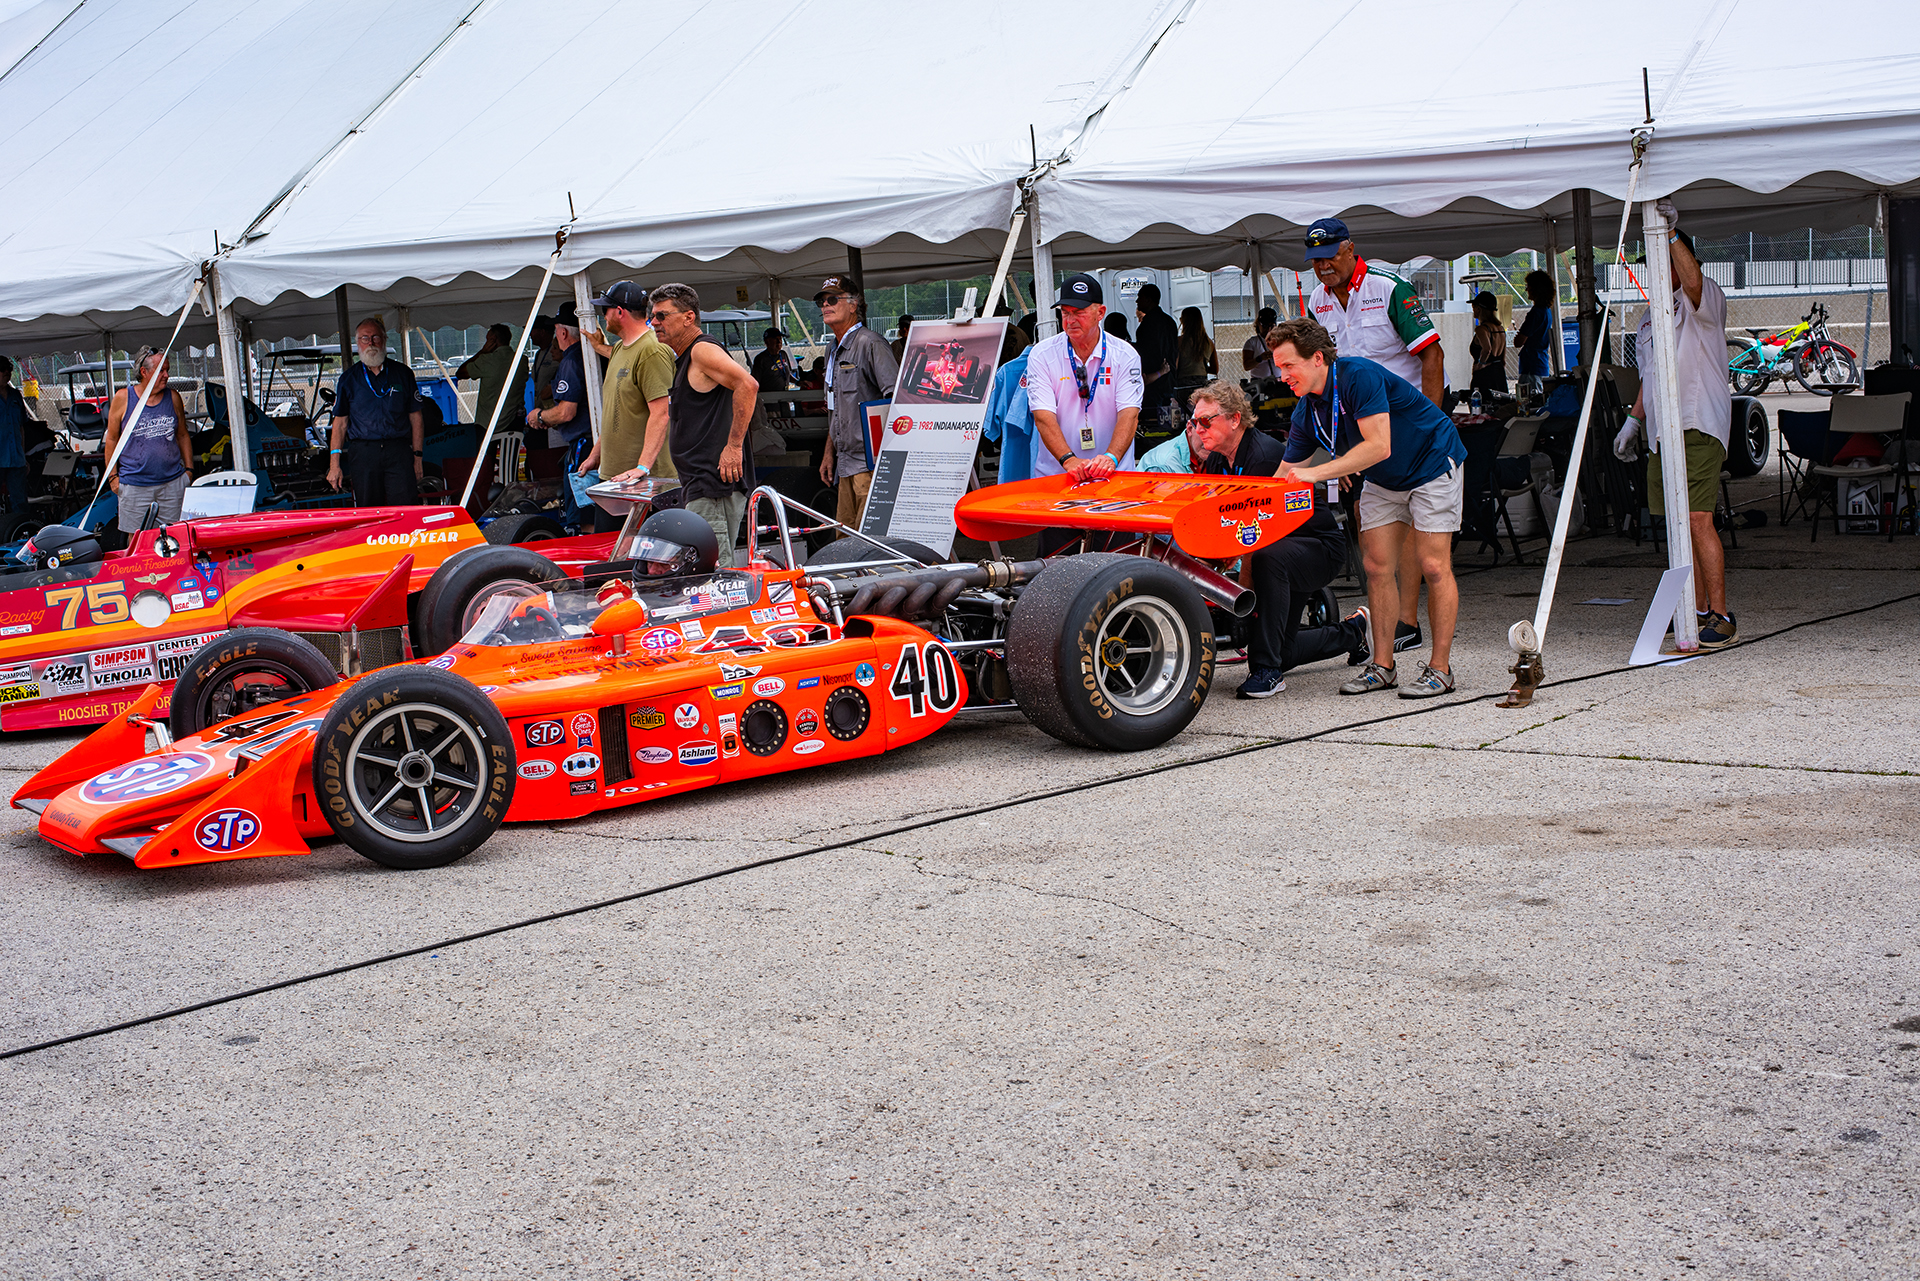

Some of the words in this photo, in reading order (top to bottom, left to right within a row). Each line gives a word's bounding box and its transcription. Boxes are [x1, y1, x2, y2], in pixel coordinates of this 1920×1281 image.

[1316, 304, 1334, 314] Castrol
[1362, 297, 1383, 305] TOYOTA
[896, 419, 910, 432] 75
[918, 421, 933, 431] 1982
[933, 421, 980, 431] INDIANAPOLIS
[261, 439, 301, 452] EAGLE
[961, 430, 979, 445] 500
[1218, 496, 1272, 513] GOODYEAR
[1286, 500, 1310, 511] KLG
[366, 528, 459, 548] GOODYEAR
[108, 563, 142, 576] Dennis
[142, 557, 186, 574] Firestone
[44, 579, 131, 631] 75
[174, 601, 190, 611] USAC
[0, 609, 46, 626] Racing
[157, 637, 199, 651] CENTER
[201, 633, 224, 644] LIN
[645, 630, 677, 649] STP
[94, 648, 146, 667] SIMPSON
[520, 650, 556, 664] Swede
[557, 645, 603, 657] Savage
[94, 667, 152, 685] VENOLIA
[508, 675, 541, 687] OIL
[548, 653, 681, 678] TREATMENT
[725, 670, 747, 680] PP
[1189, 631, 1214, 709] EAGLE
[58, 679, 84, 687] CYCLONE
[757, 681, 781, 693] BELL
[799, 679, 819, 687] NORTON
[823, 672, 854, 686] Nisonger
[889, 641, 960, 718] 40
[716, 686, 740, 697] MONROE
[58, 703, 110, 722] HOOSIER
[632, 713, 665, 726] PREMIER
[531, 722, 561, 743] STP
[574, 721, 593, 730] Great
[577, 728, 592, 736] Ones
[679, 746, 718, 759] Ashland
[523, 764, 551, 775] BELL
[94, 757, 204, 799] STP
[483, 744, 508, 823] EAGLE
[200, 811, 257, 850] STP
